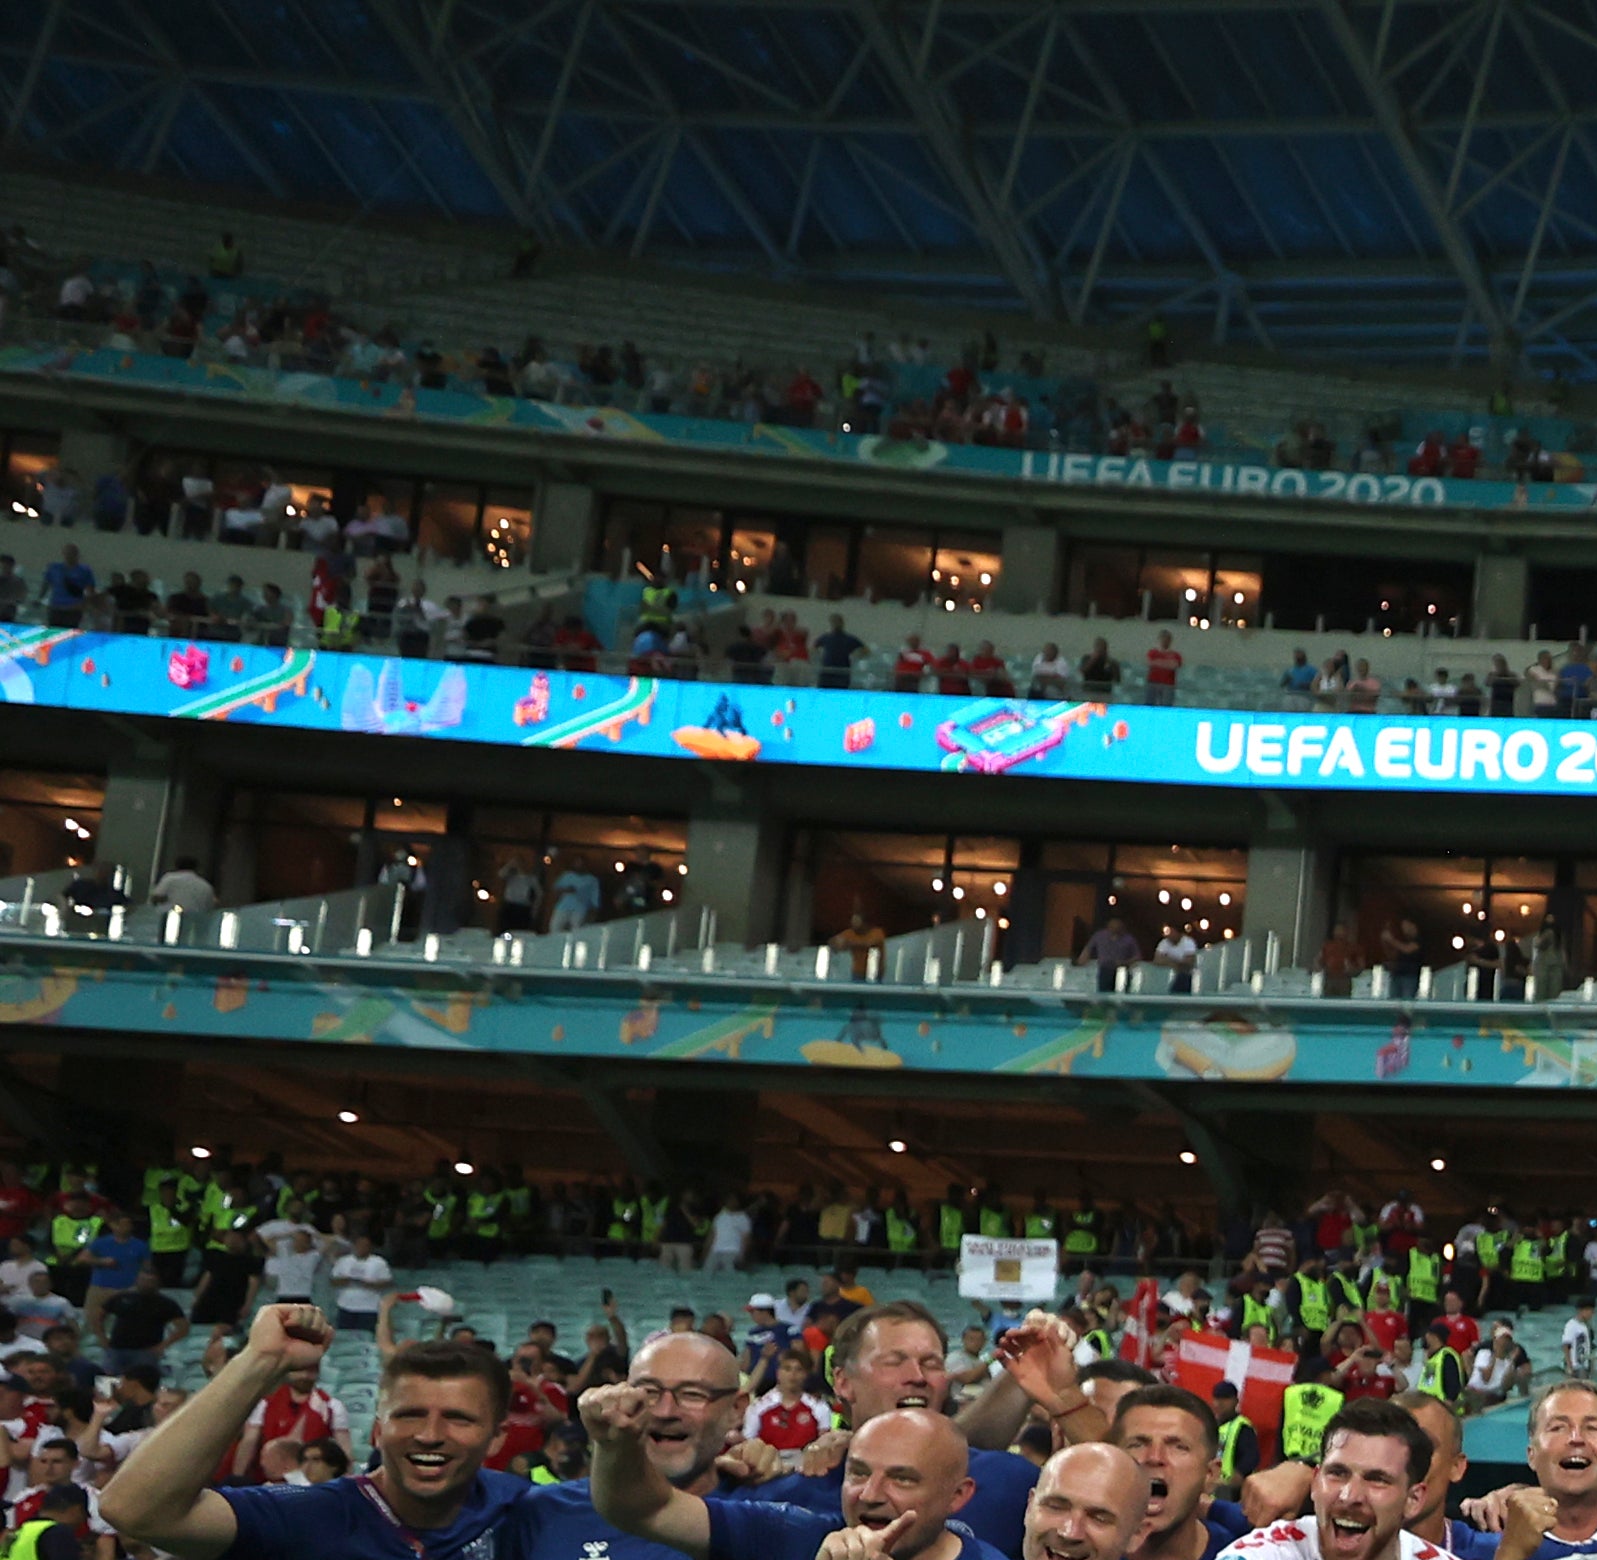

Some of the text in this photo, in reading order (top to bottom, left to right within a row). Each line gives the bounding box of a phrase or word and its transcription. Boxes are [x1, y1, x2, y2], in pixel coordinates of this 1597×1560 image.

[1020, 450, 1446, 506] UEFA EURO 2020
[1196, 721, 1365, 778] UEFA
[1374, 726, 1549, 783] EURO
